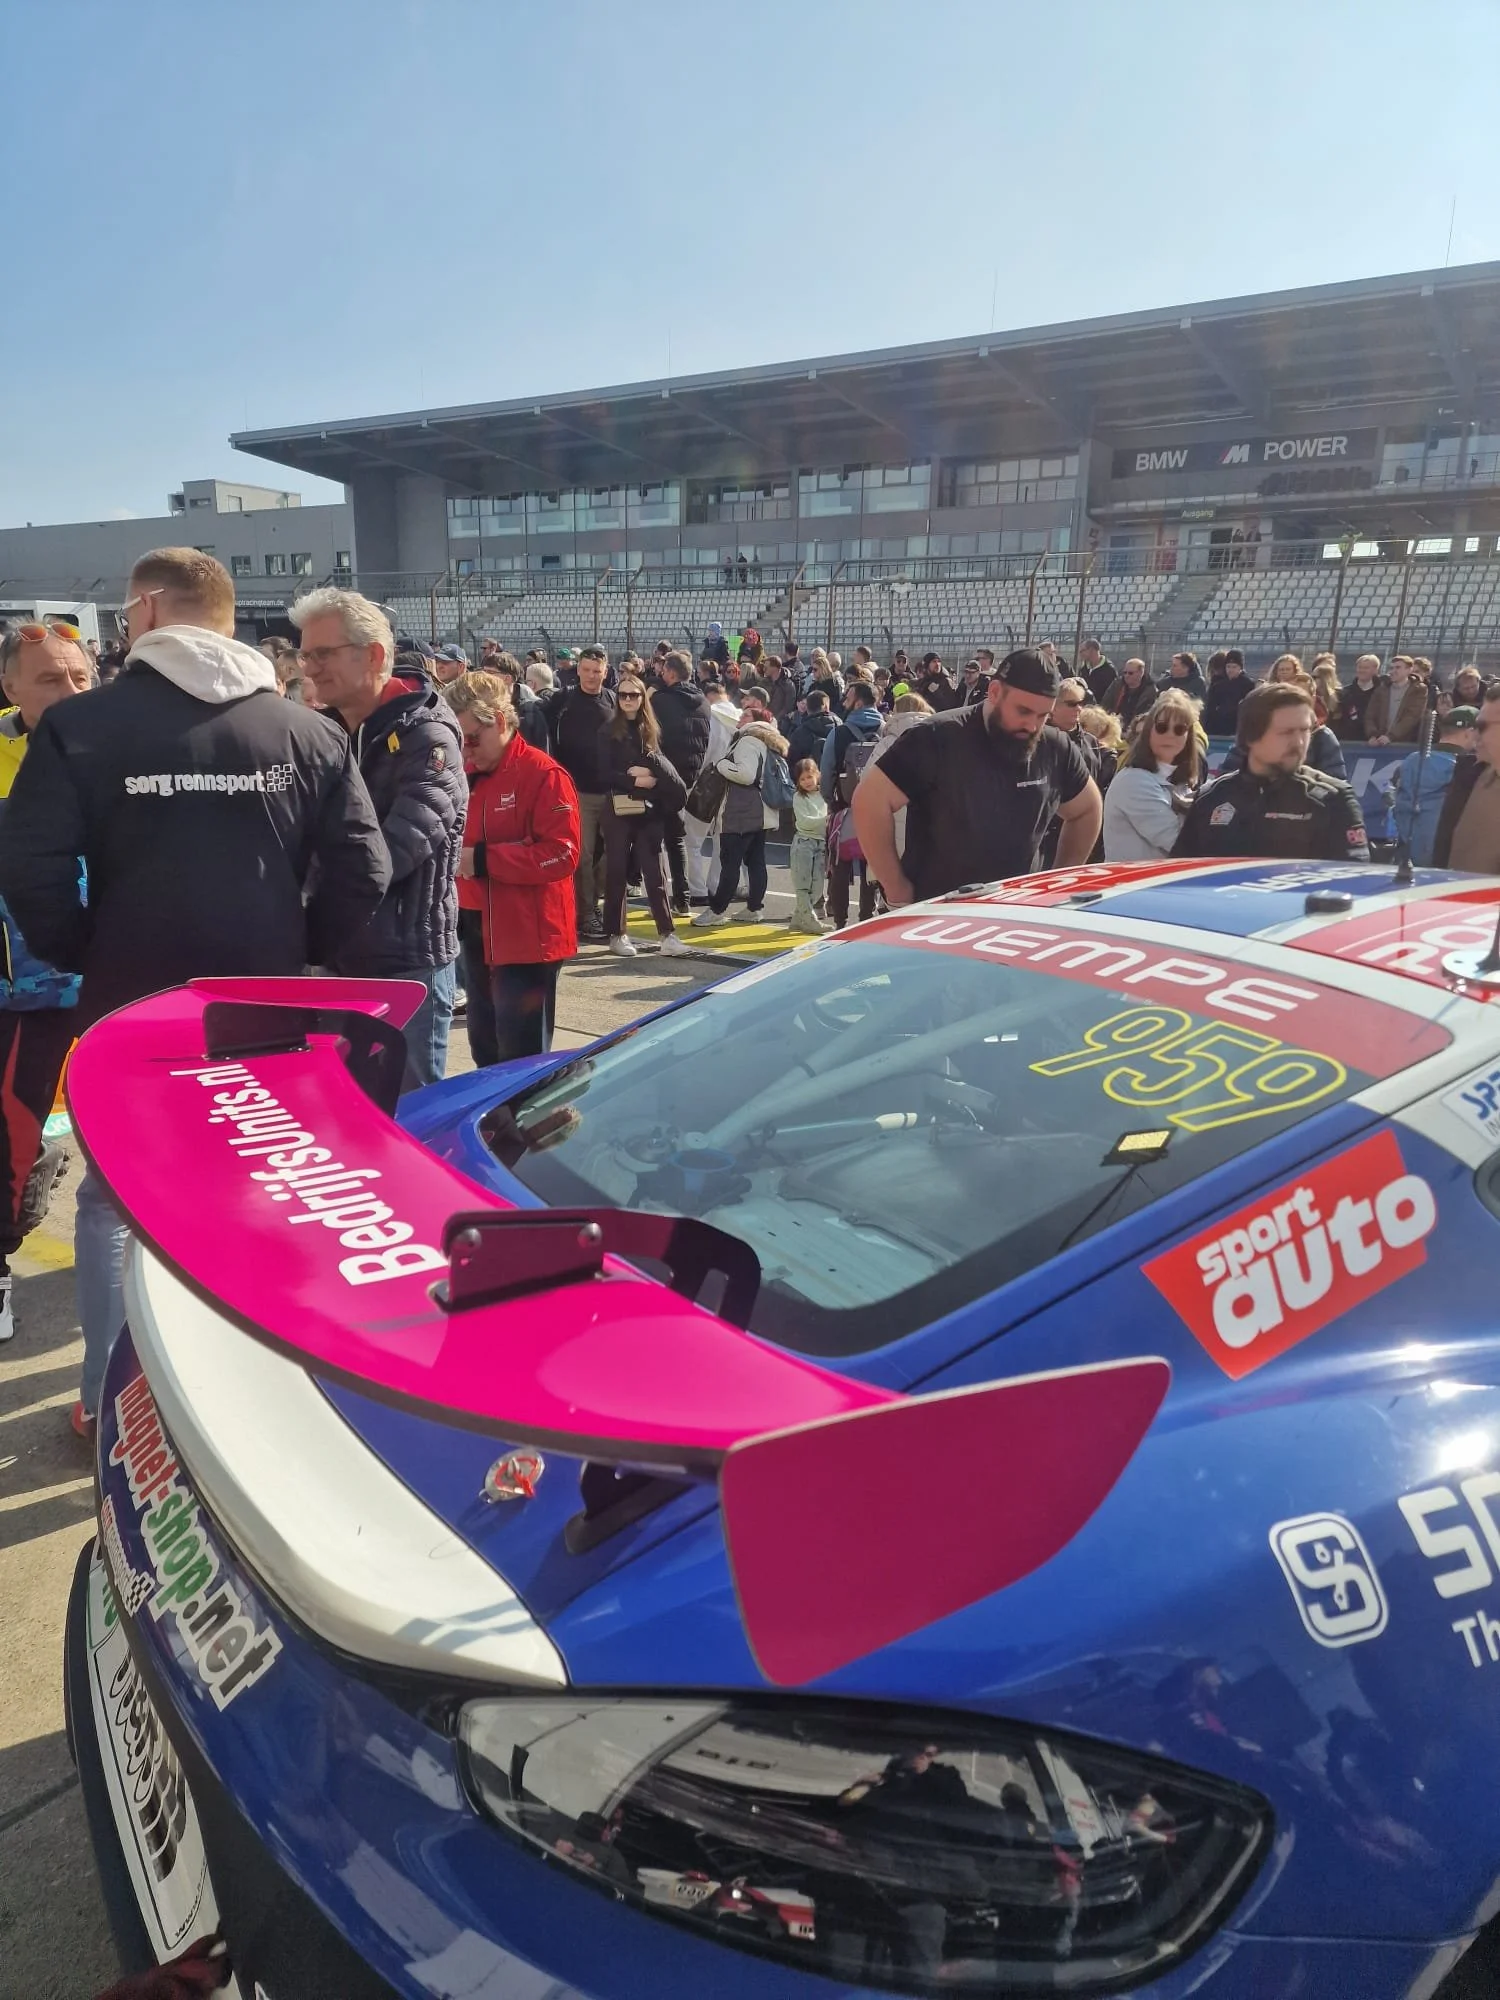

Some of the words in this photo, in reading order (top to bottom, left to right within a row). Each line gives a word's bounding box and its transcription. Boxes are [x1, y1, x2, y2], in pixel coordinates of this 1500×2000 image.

[1136, 450, 1188, 471] BMW
[1264, 436, 1348, 460] POWER
[1181, 508, 1214, 521] Ausgang
[125, 774, 174, 797] sorg
[174, 771, 265, 795] rennsport
[901, 919, 1319, 1020] WEMPE
[1029, 1007, 1347, 1132] 959
[1196, 1187, 1321, 1287] sport
[1213, 1175, 1436, 1349] auto
[110, 1372, 277, 1704] magnet-shop.net
